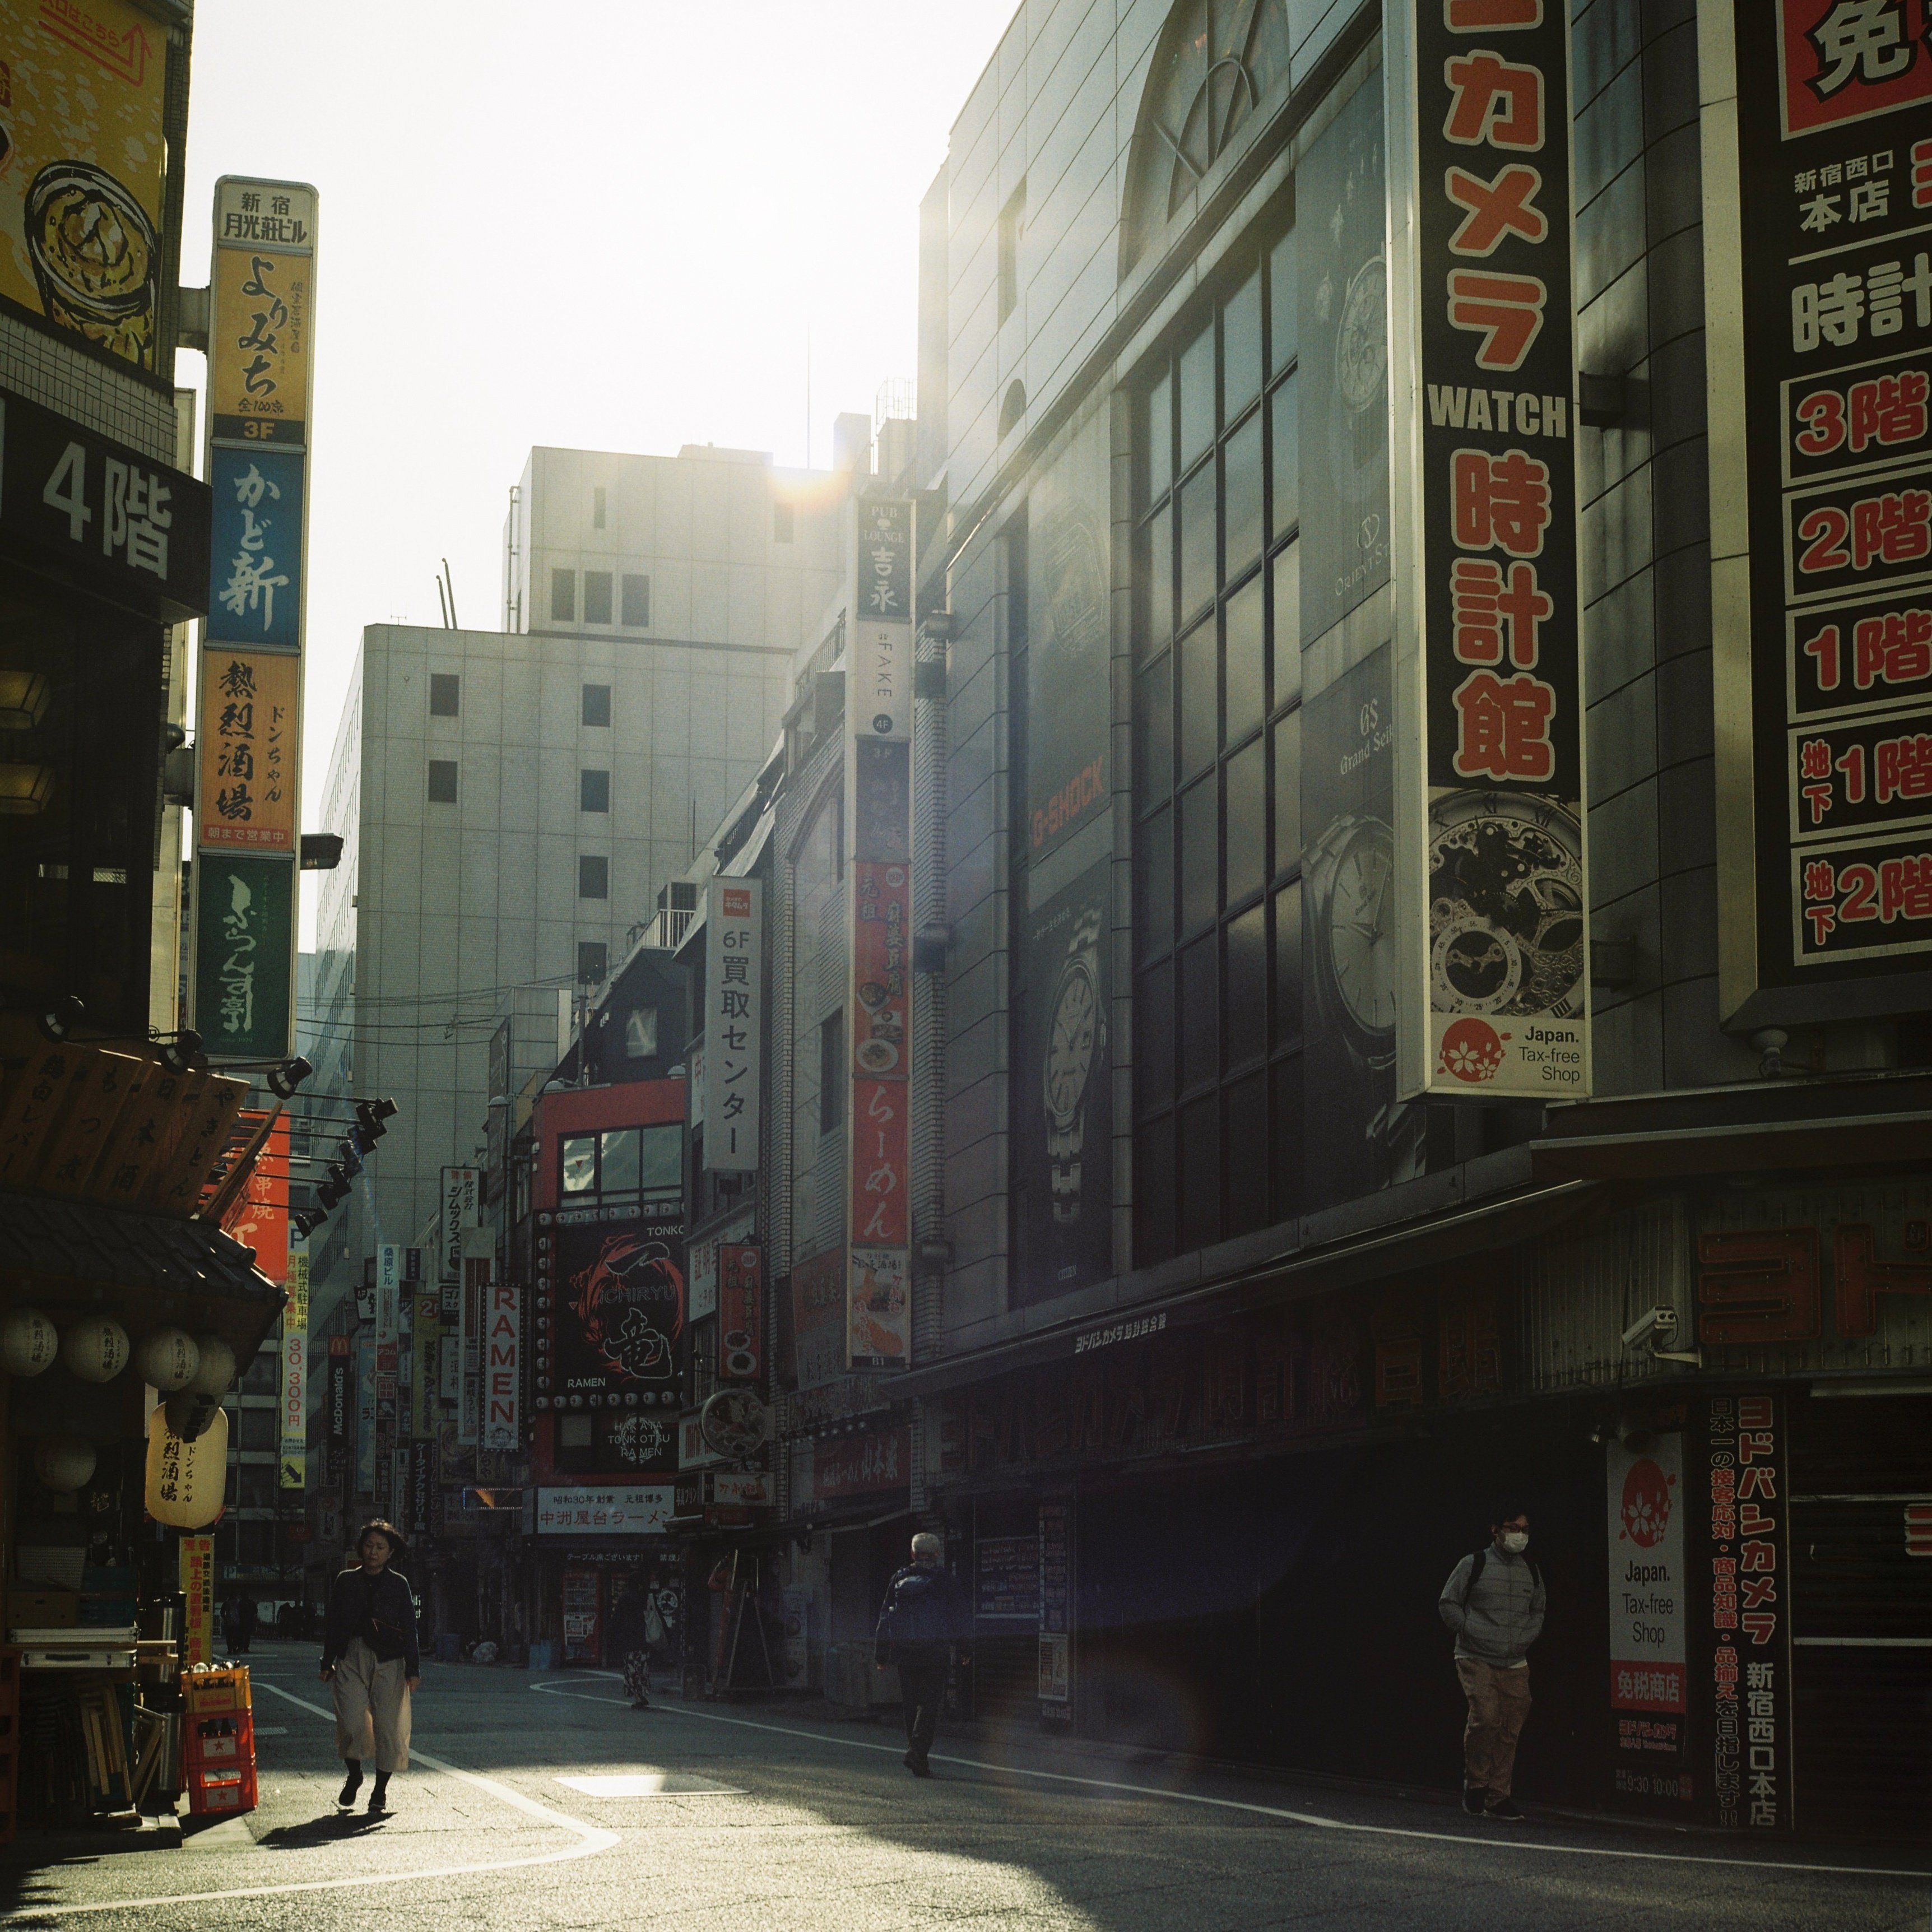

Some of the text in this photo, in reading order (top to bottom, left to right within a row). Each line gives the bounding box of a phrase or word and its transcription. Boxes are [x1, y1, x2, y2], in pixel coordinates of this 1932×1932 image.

[1815, 0, 1932, 94] 免
[1794, 150, 1894, 193] 新宿西口
[242, 192, 290, 215] 新宿
[1799, 180, 1889, 233] 本店
[239, 256, 288, 397] よりみち
[244, 421, 275, 440] 3F
[1428, 383, 1567, 439] WATCH
[1795, 370, 1929, 456] 3階
[43, 440, 172, 580] 4階
[864, 530, 904, 544] LOUNGE
[871, 506, 898, 518] PUB
[1798, 487, 1931, 575] 2階
[220, 464, 290, 632] かど新
[870, 546, 898, 613] 吉永
[1451, 448, 1556, 782] 時計館
[877, 643, 893, 697] FAKE
[1803, 609, 1932, 691] 1階
[216, 660, 257, 821] 熱烈酒場
[876, 719, 889, 729] 4F
[266, 705, 285, 803] ドンちゃん
[1340, 740, 1371, 776] Grand
[1800, 733, 1932, 824] 地下 1階
[1032, 760, 1104, 848] G-SHOCK
[208, 827, 285, 842] 朝まで営業中
[1803, 852, 1932, 947] 地下 2階
[1519, 1046, 1580, 1064] Tax-free
[1525, 1026, 1580, 1045] Japan.
[1542, 1065, 1581, 1084] Shop
[863, 1085, 897, 1238] らーめん
[290, 1227, 307, 1249] P
[600, 1285, 676, 1304] ICHIRYU
[288, 1338, 301, 1427] 30,300円
[490, 1287, 518, 1423] RAMEN
[567, 1377, 606, 1388] RAMEN
[333, 1367, 344, 1436] McDonald's
[182, 1446, 196, 1503] ドンちゃん
[554, 1494, 663, 1504] 昭和30年創業 元祖博多
[1737, 1396, 1776, 1645] ヨドバシカメラ
[1625, 1561, 1670, 1585] Japan.
[1622, 1592, 1674, 1615] Tax-free
[1632, 1620, 1665, 1647] Shop
[1617, 1669, 1680, 1705] 免税商店
[1745, 1662, 1776, 1827] 新宿西口本店
[1627, 1775, 1649, 1794] 9:30
